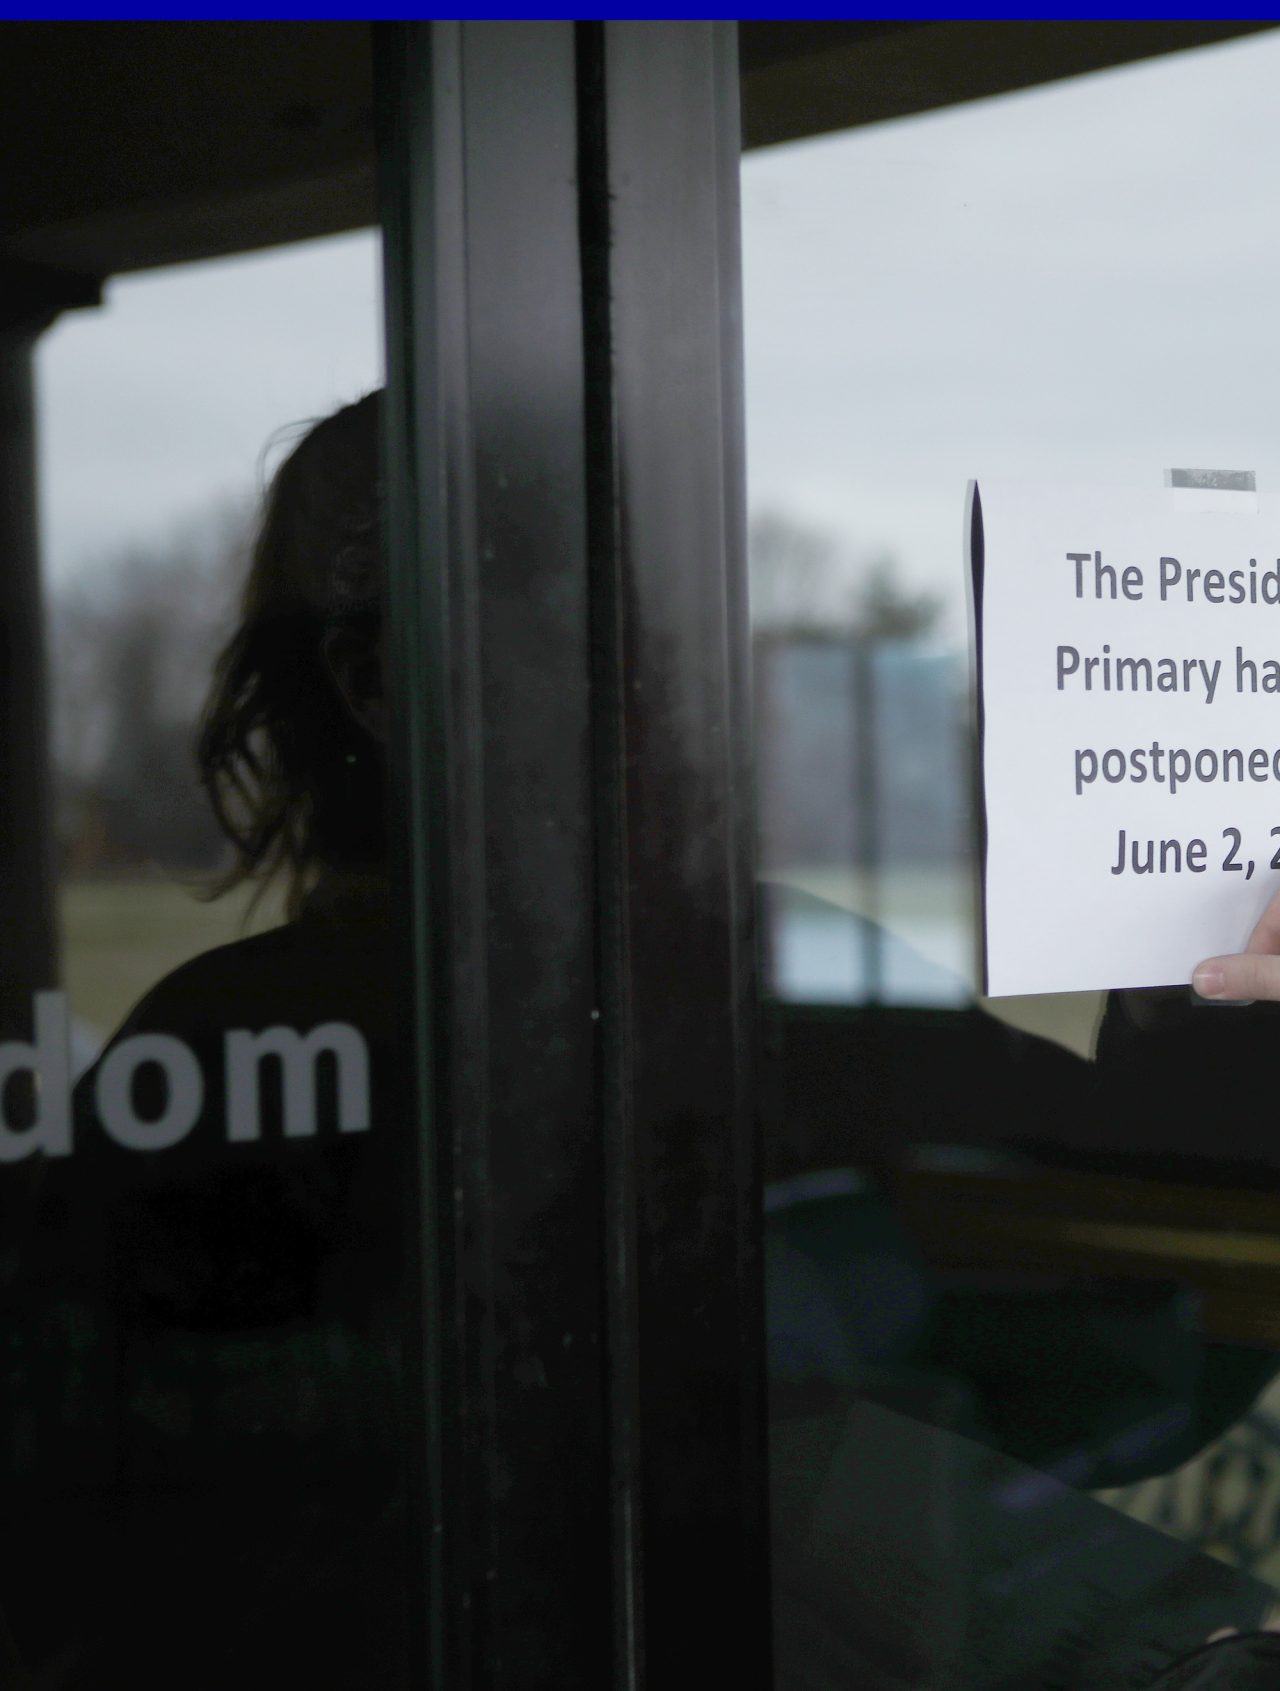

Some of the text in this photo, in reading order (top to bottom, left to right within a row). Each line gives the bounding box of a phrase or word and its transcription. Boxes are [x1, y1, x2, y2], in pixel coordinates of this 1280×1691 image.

[1066, 550, 1144, 601] The
[1056, 644, 1222, 704] Primary
[1110, 829, 1208, 876] June
[1221, 826, 1256, 880] 2,
